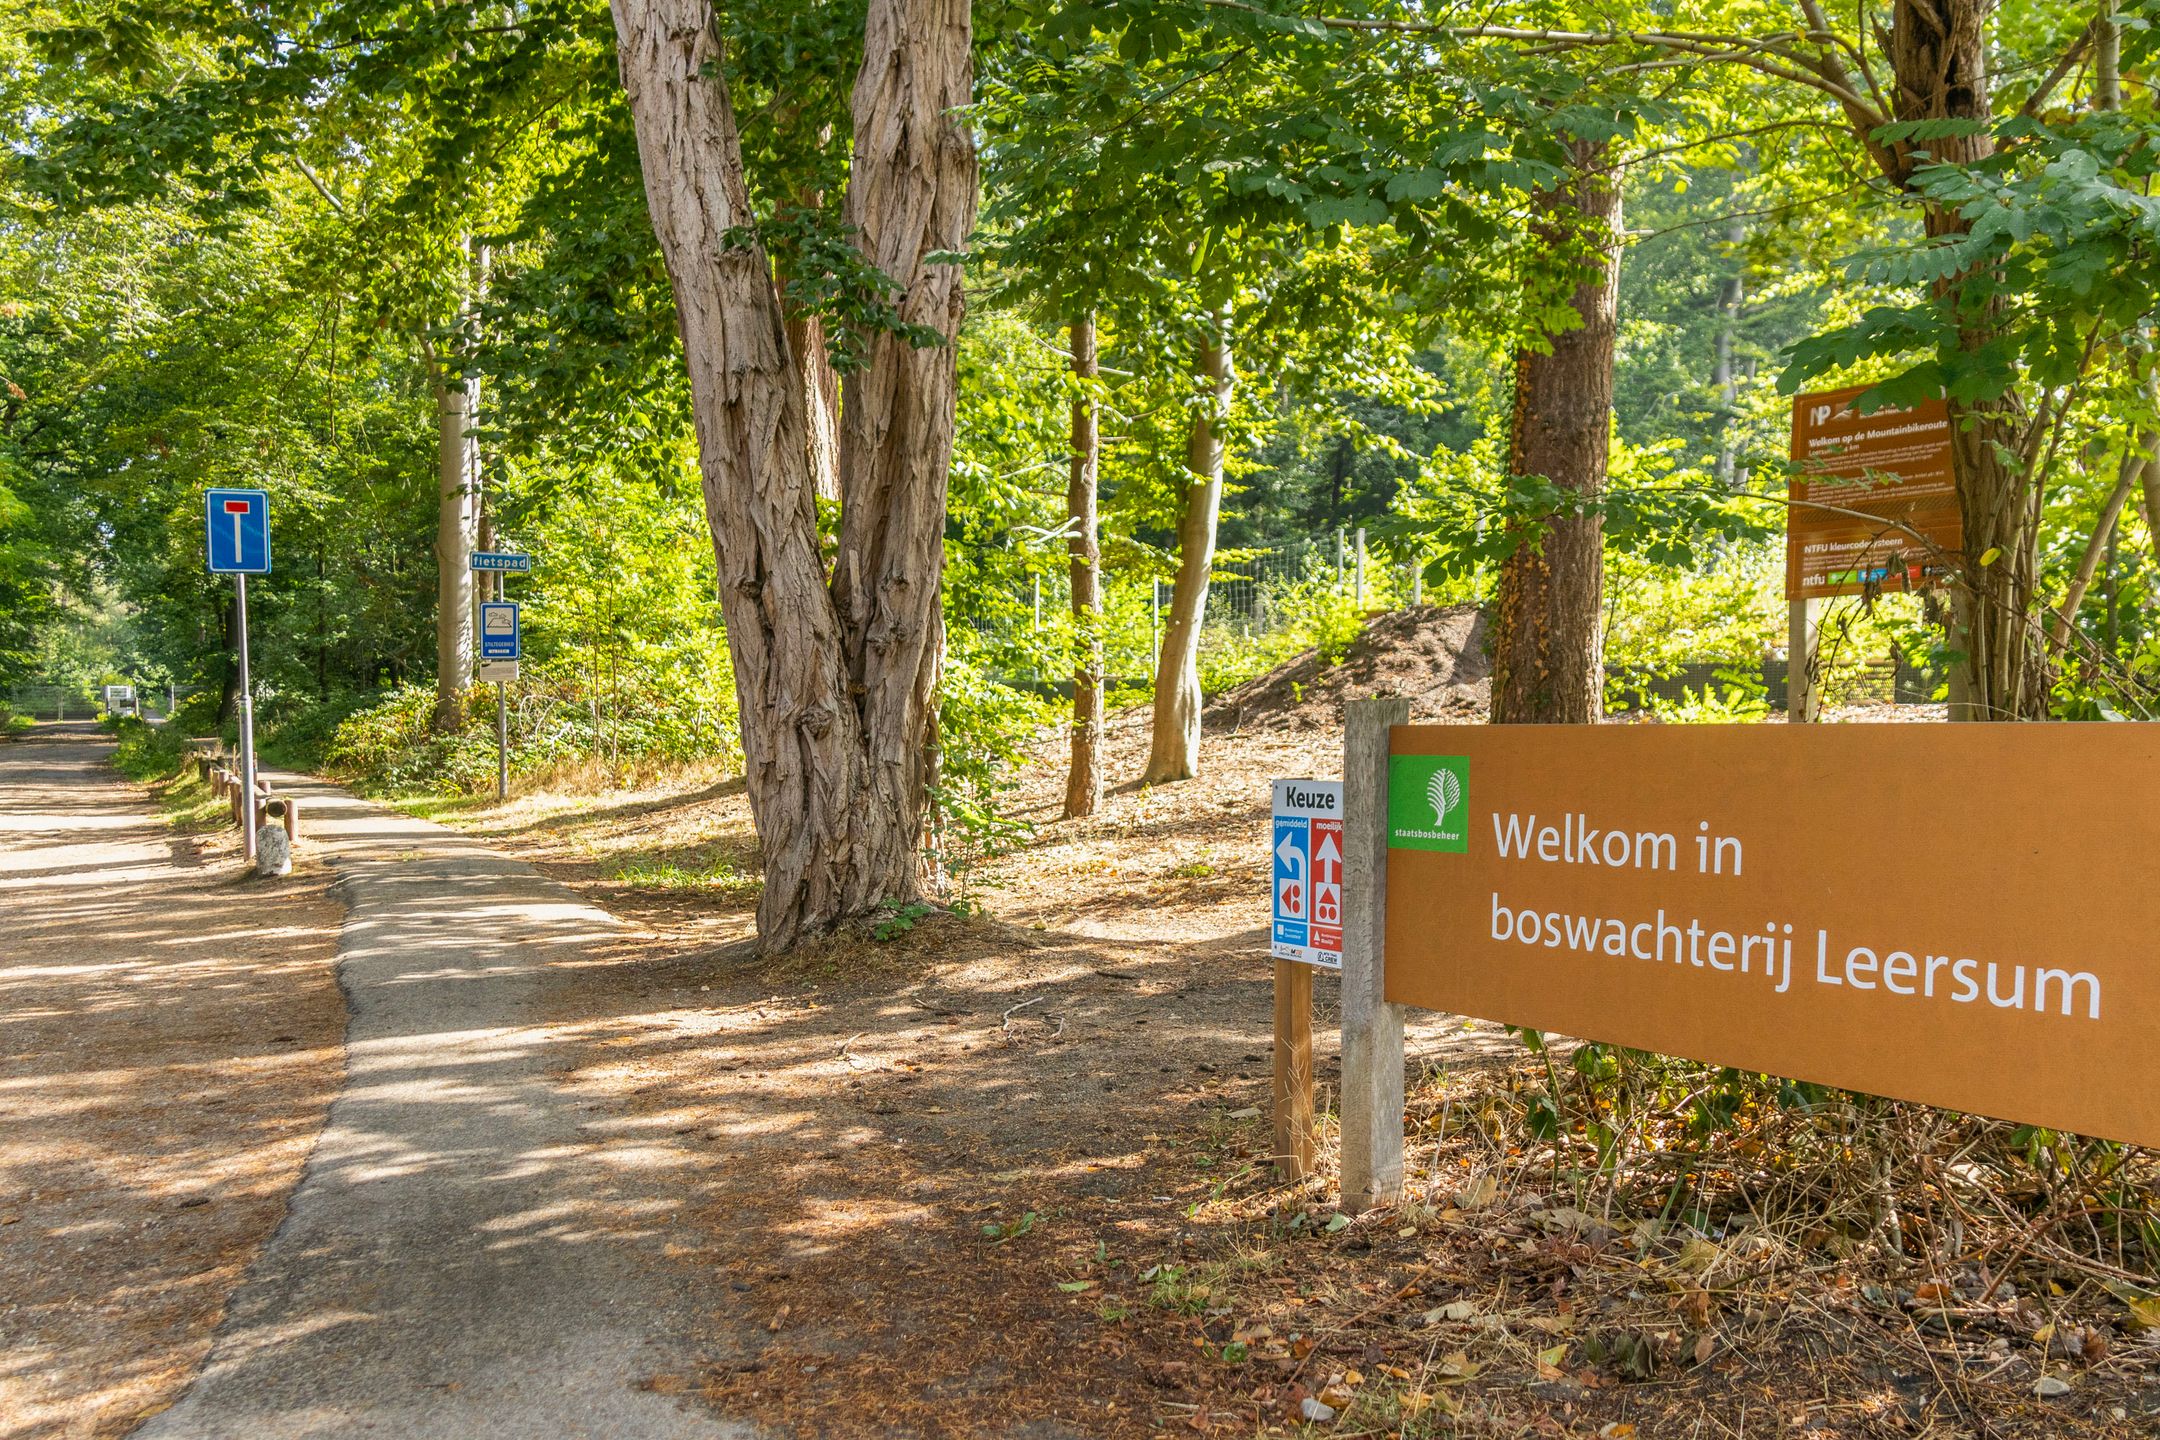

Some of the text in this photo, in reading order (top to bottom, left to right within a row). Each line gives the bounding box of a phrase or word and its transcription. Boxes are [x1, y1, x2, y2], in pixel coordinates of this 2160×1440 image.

[1810, 405, 1831, 427] NP
[1809, 420, 1948, 447] Welkom op de Mountainbikeroute
[1804, 538, 1903, 553] NTFU kleurcodeysteem
[474, 556, 526, 569] fietspad
[1802, 573, 1826, 586] ntfu
[1286, 786, 1335, 809] Keuze
[1275, 819, 1308, 829] gemiddeld
[1316, 821, 1343, 833] moeilijk
[1395, 829, 1460, 840] staatsbosbeheer
[1492, 812, 1743, 876] Welkom in
[1490, 892, 2101, 1019] boswachterij Leersum
